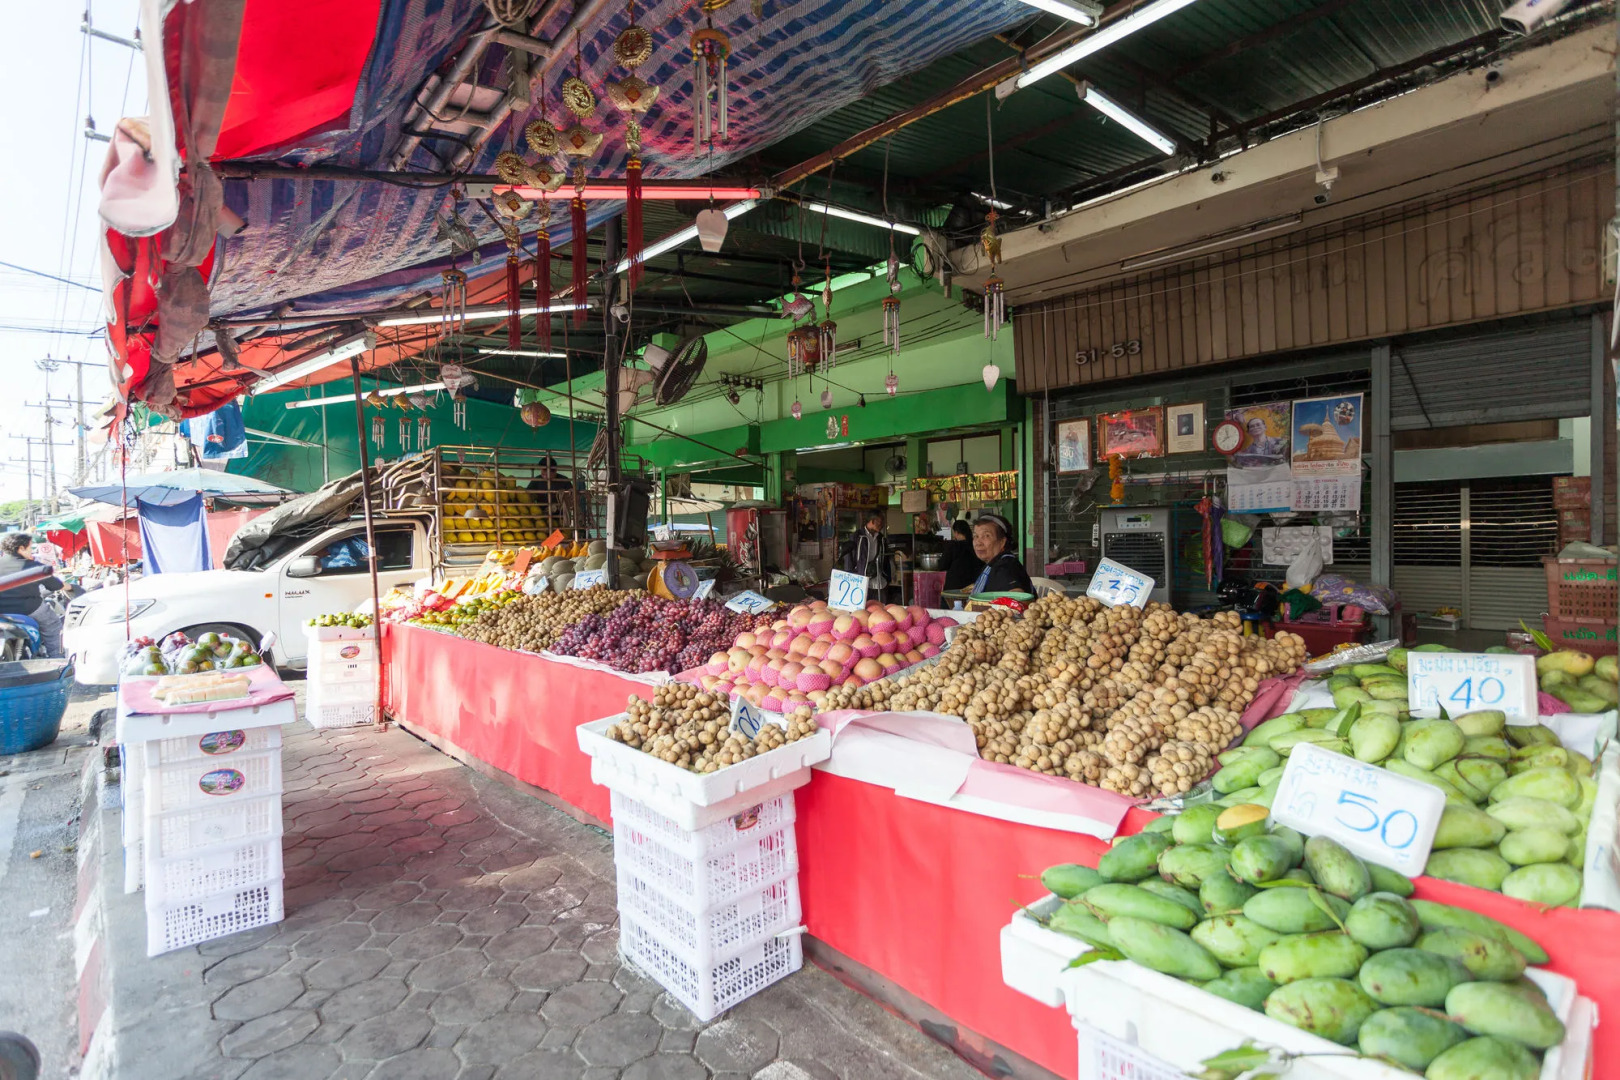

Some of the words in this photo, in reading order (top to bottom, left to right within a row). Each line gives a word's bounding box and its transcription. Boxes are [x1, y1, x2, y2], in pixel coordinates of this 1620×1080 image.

[1075, 340, 1140, 365] 51-53
[738, 597, 762, 608] 100
[839, 580, 864, 606] 20
[1109, 580, 1140, 604] 35
[1449, 676, 1505, 709] 40
[1335, 789, 1418, 850] 50
